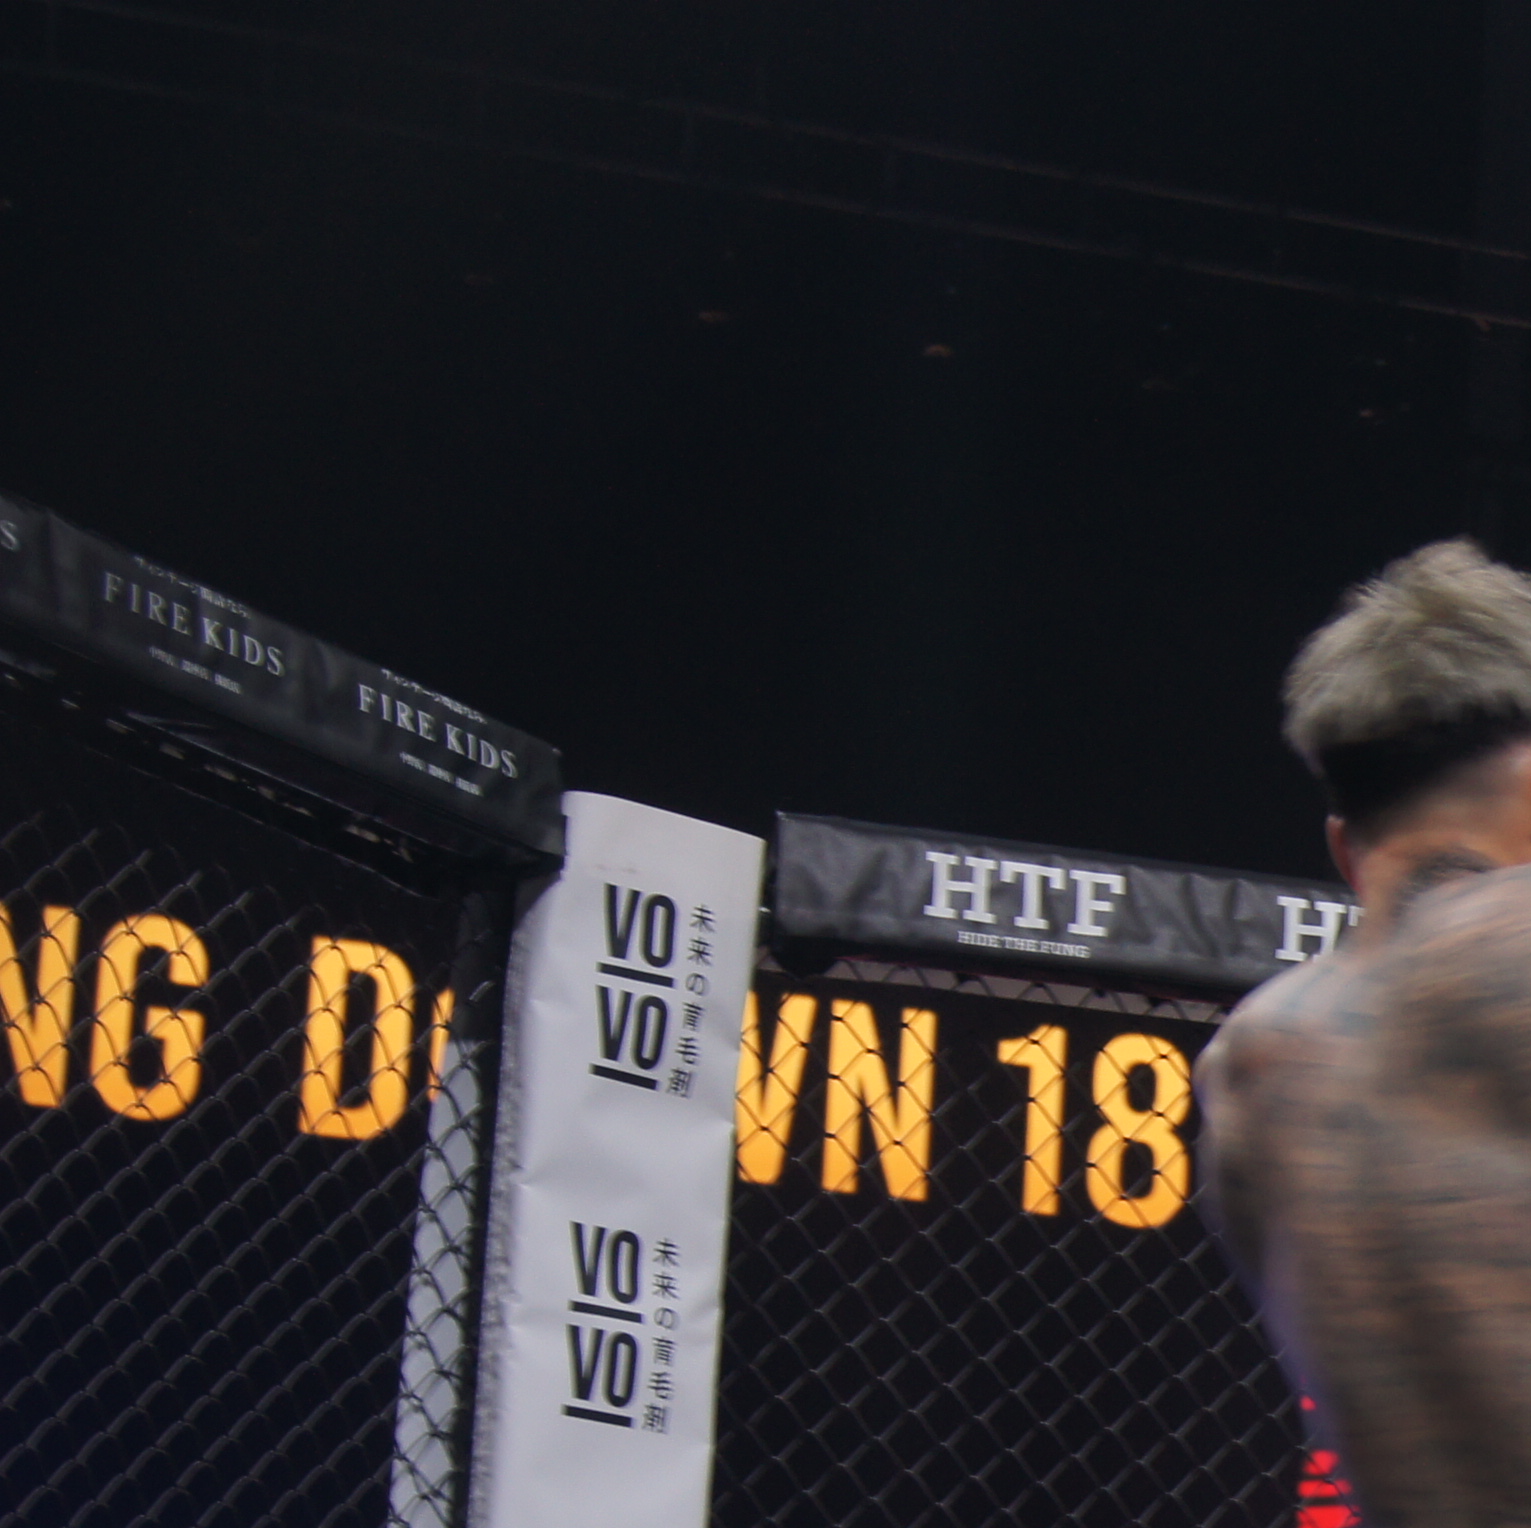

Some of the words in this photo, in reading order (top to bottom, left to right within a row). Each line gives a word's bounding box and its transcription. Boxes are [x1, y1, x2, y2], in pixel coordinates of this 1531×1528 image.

[103, 571, 192, 636] FIRE
[201, 616, 285, 677] KIDS
[358, 683, 437, 742] FIRE
[445, 722, 518, 779] KIDS
[923, 851, 1127, 938] HTF
[997, 1023, 1192, 1230] 18
